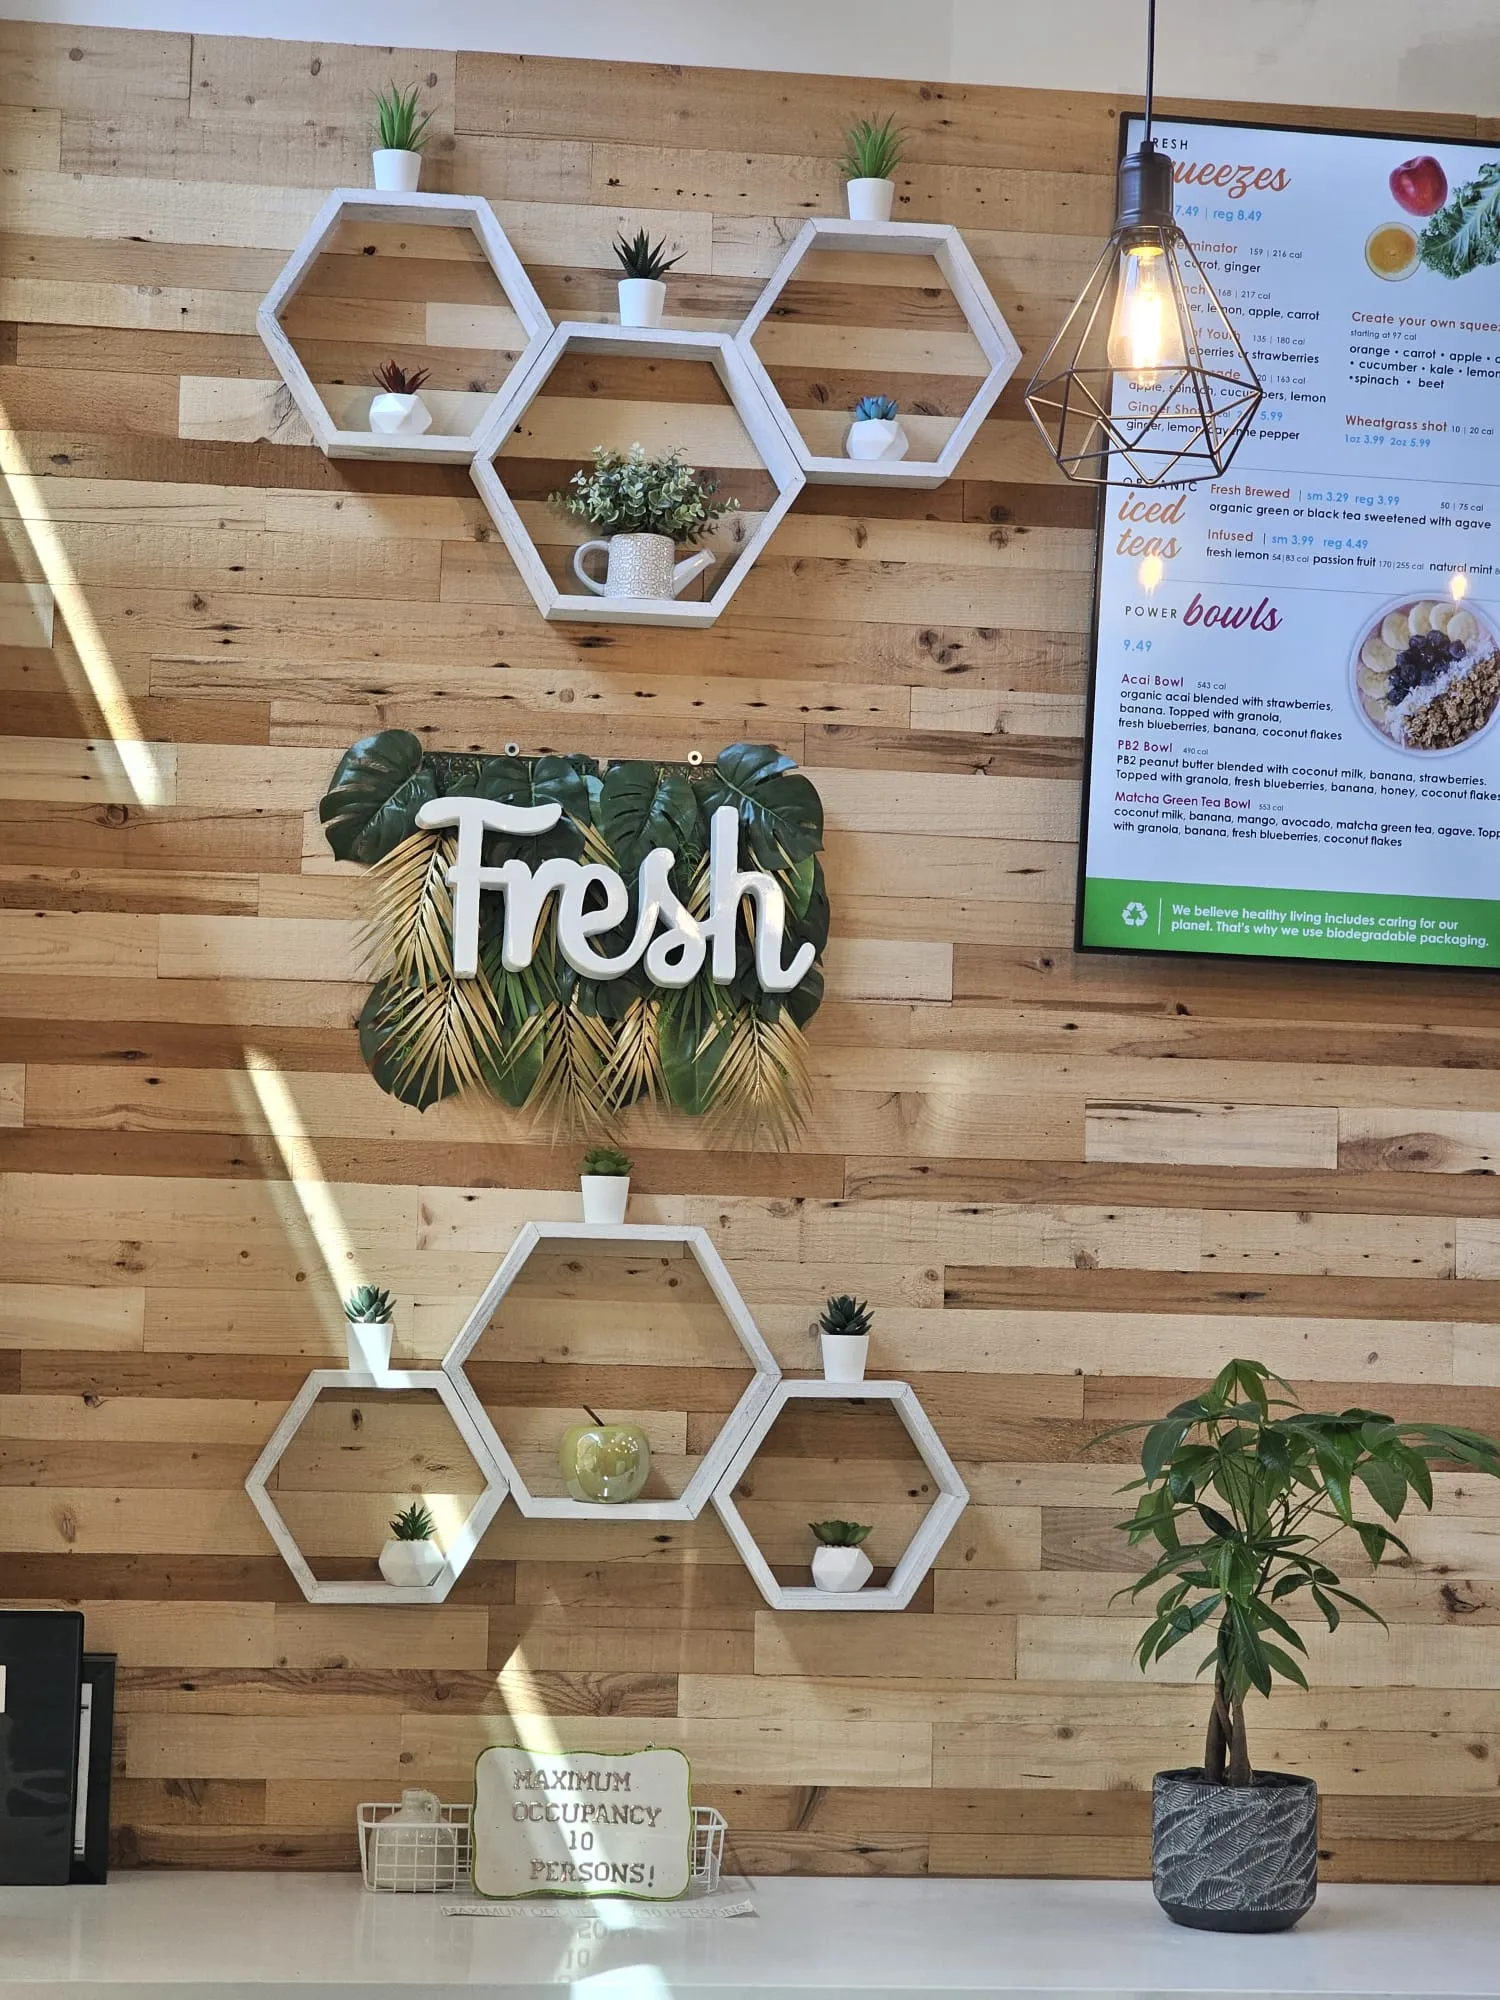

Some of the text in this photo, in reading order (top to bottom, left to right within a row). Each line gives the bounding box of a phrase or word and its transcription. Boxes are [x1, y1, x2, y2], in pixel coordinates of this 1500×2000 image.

[1152, 137, 1188, 150] RESH
[1175, 205, 1262, 222] 7.49 reg 8.49
[1289, 251, 1302, 259] cal
[1224, 261, 1261, 274] ginger
[1258, 292, 1271, 300] cal
[1248, 307, 1320, 321] apple, carrot
[1352, 311, 1456, 328] Create your own
[1292, 337, 1306, 346] cal
[1350, 329, 1380, 340] starting
[1404, 333, 1417, 341] cal
[1252, 350, 1320, 364] strawberries
[1350, 345, 1390, 358] orange
[1403, 349, 1436, 359] carrot
[1450, 352, 1482, 364] apple
[1359, 360, 1454, 375] cucumber kale
[1292, 376, 1306, 385] cal
[1418, 378, 1444, 389] beet
[1290, 390, 1326, 403] lemon
[1260, 410, 1283, 421] 5.99
[1345, 414, 1494, 436] Wheatgrass shot cal
[1260, 428, 1300, 441] pepper
[1364, 434, 1432, 448] 3.99 5.99
[1210, 484, 1240, 496] Fresh
[1245, 485, 1290, 499] Brewed
[1306, 492, 1322, 501] sm
[1326, 492, 1350, 503] 3.29
[1355, 495, 1374, 506] reg
[1117, 492, 1187, 525] iced
[1209, 503, 1492, 530] organic green or black tea sweetened with agave
[1440, 501, 1484, 512] 50 75 cal
[1116, 528, 1182, 560] teas
[1208, 529, 1254, 542] Infused
[1272, 534, 1288, 545] sm
[1323, 538, 1342, 550] reg
[1345, 538, 1369, 550] 4.49
[1206, 547, 1232, 558] fresh
[1234, 548, 1270, 560] lemon
[1312, 554, 1354, 566] passion
[1356, 556, 1376, 567] fruit
[1430, 562, 1467, 573] natural
[1470, 564, 1492, 574] mint
[1125, 592, 1284, 632] POWER bowls
[1123, 639, 1152, 652] 9.49
[1121, 673, 1226, 690] Acai Bowl cal
[1120, 690, 1334, 712] organic acai blended with strawberries,
[1120, 703, 1282, 724] banana. Topped with granola,
[1118, 718, 1342, 740] fresh blueberries, banana, coconut flakes
[1118, 740, 1140, 752] PB2
[1144, 741, 1173, 754] Bowl
[1116, 754, 1487, 786] PB2 peanut butter blended with coconut milk, banana, strawberries.
[1116, 769, 1468, 800] Topped with granola, fresh blueberries, banana, honey, coconut
[1114, 791, 1284, 812] Matcha Green Tea Bowl cal
[1114, 808, 1475, 838] coconut milk, banana, mango, avocado, matcha green tea, agave.
[1113, 821, 1402, 847] with granola, banana, fresh blueberries, coconut flakes
[414, 796, 816, 993] Fresh
[1172, 904, 1459, 930] We believe healthy living includes caring for our
[1171, 920, 1489, 948] planet. That's why we use biodegradable packaging.
[512, 1767, 632, 1793] MAXIMUM
[511, 1800, 662, 1829] OCCUPANCY
[568, 1830, 594, 1851] 10
[529, 1858, 656, 1889] PERSONS!
